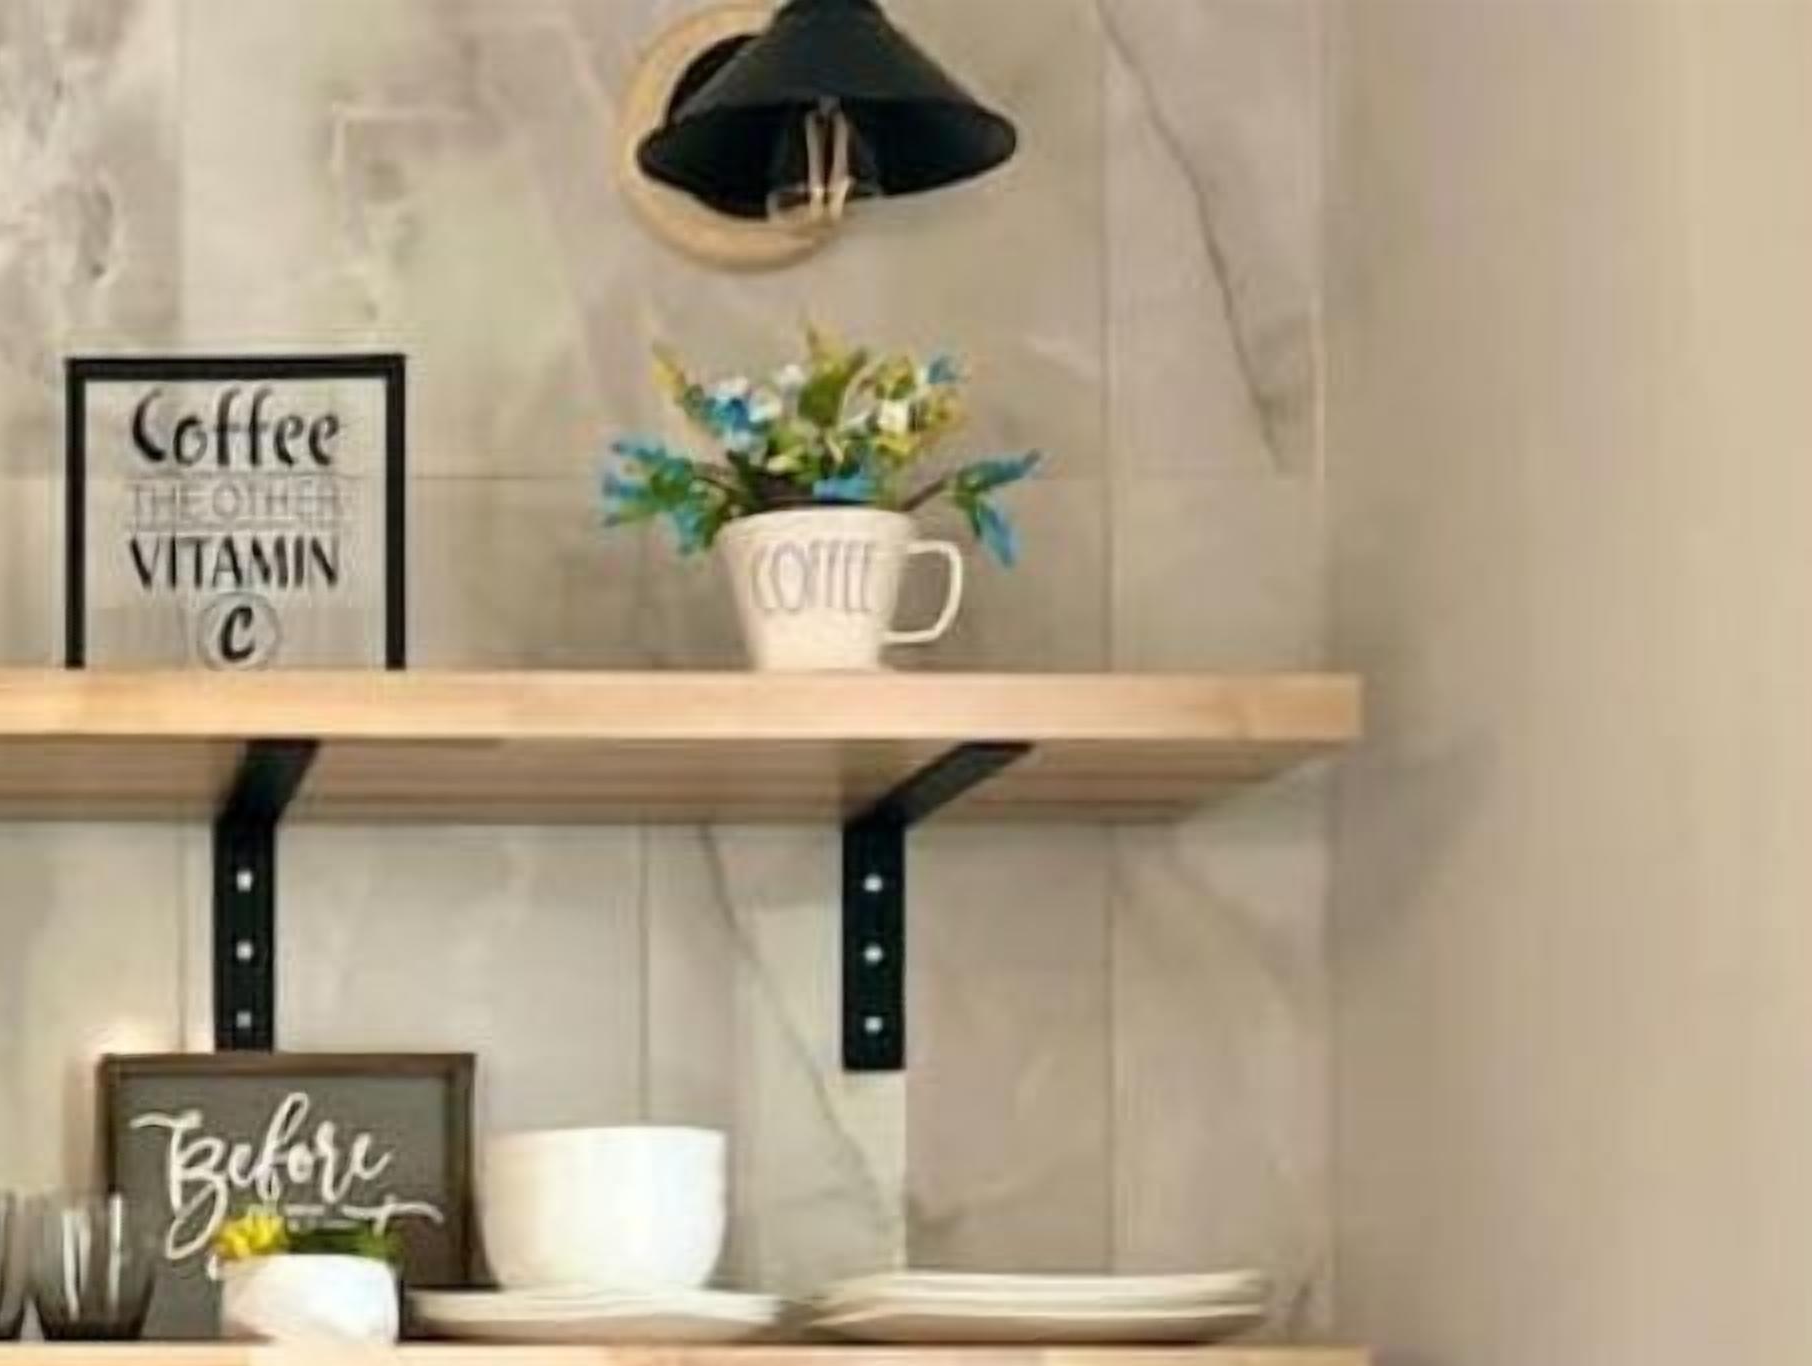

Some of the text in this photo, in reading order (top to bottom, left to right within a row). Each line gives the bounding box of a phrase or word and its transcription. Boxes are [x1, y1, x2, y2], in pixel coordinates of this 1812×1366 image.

[131, 387, 339, 466] Coffee
[130, 535, 339, 588] VITAMIN
[130, 1092, 392, 1260] Before
